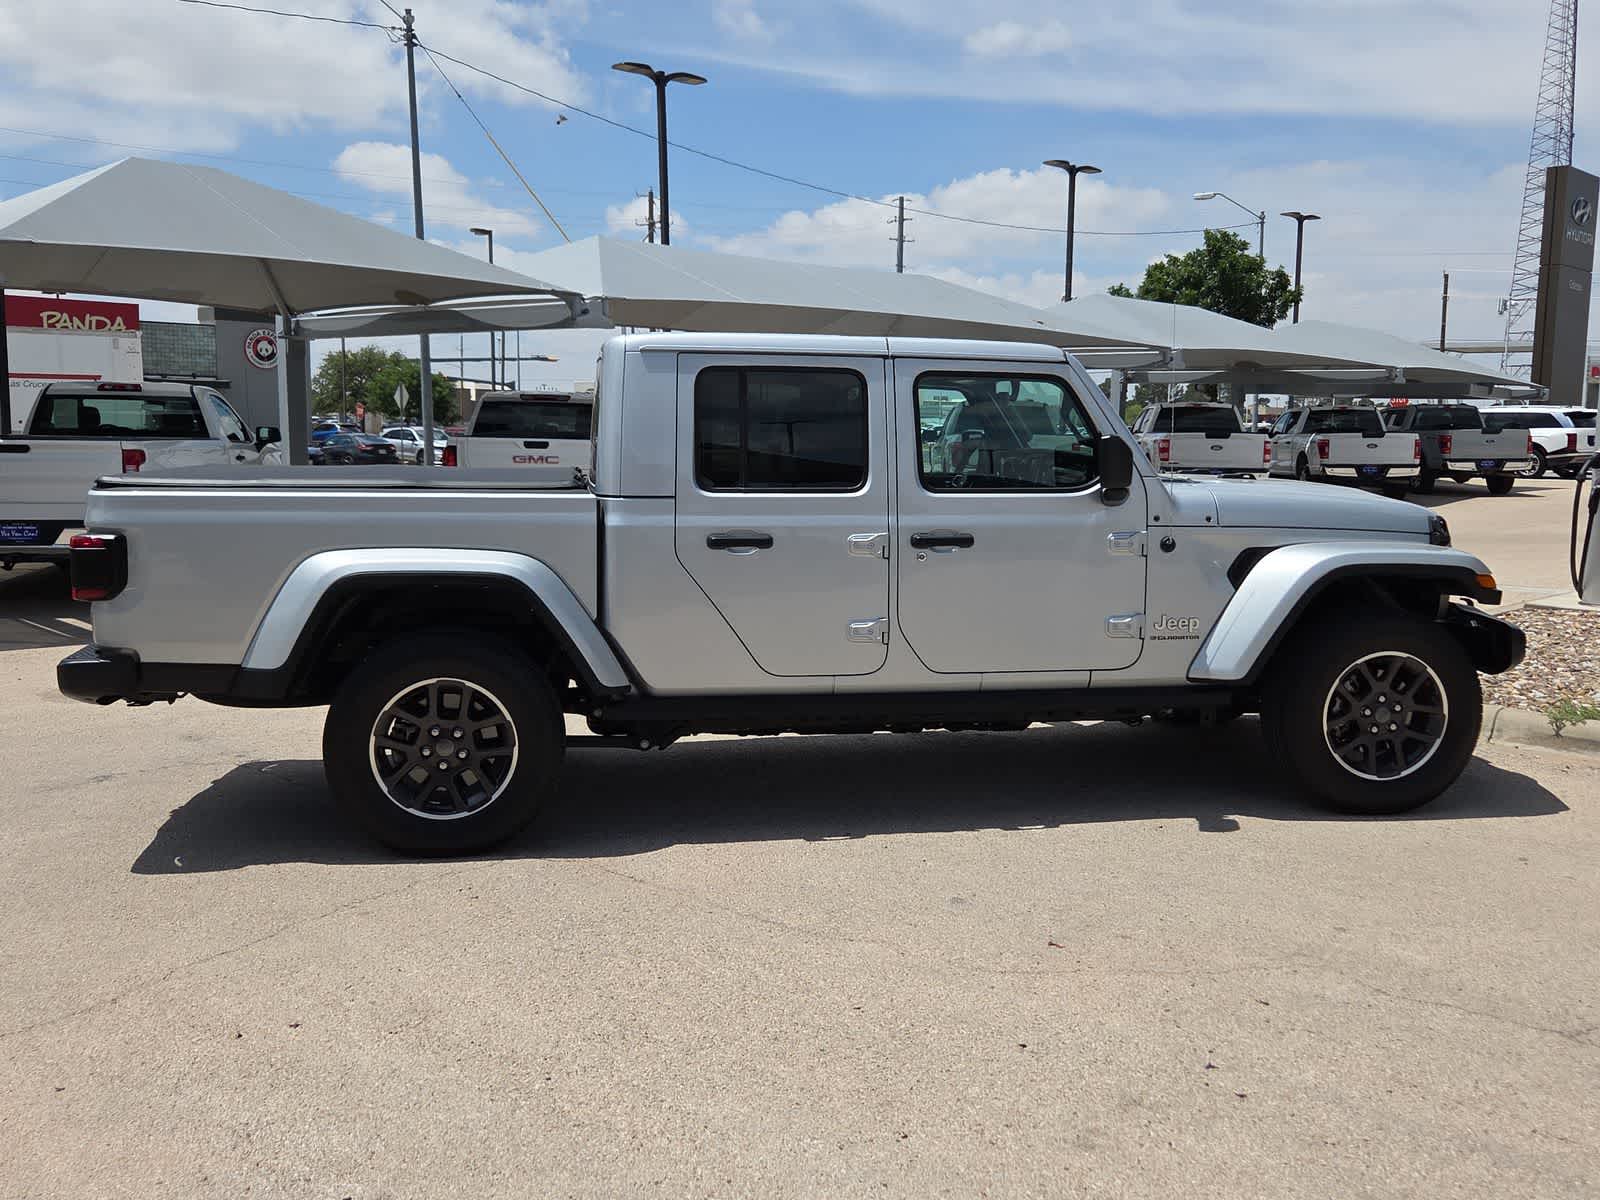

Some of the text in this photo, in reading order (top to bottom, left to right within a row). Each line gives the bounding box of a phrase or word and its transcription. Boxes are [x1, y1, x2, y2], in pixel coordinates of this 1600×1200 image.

[40, 310, 138, 332] PANDA
[512, 455, 560, 465] GMC
[1154, 615, 1200, 633] Jeep
